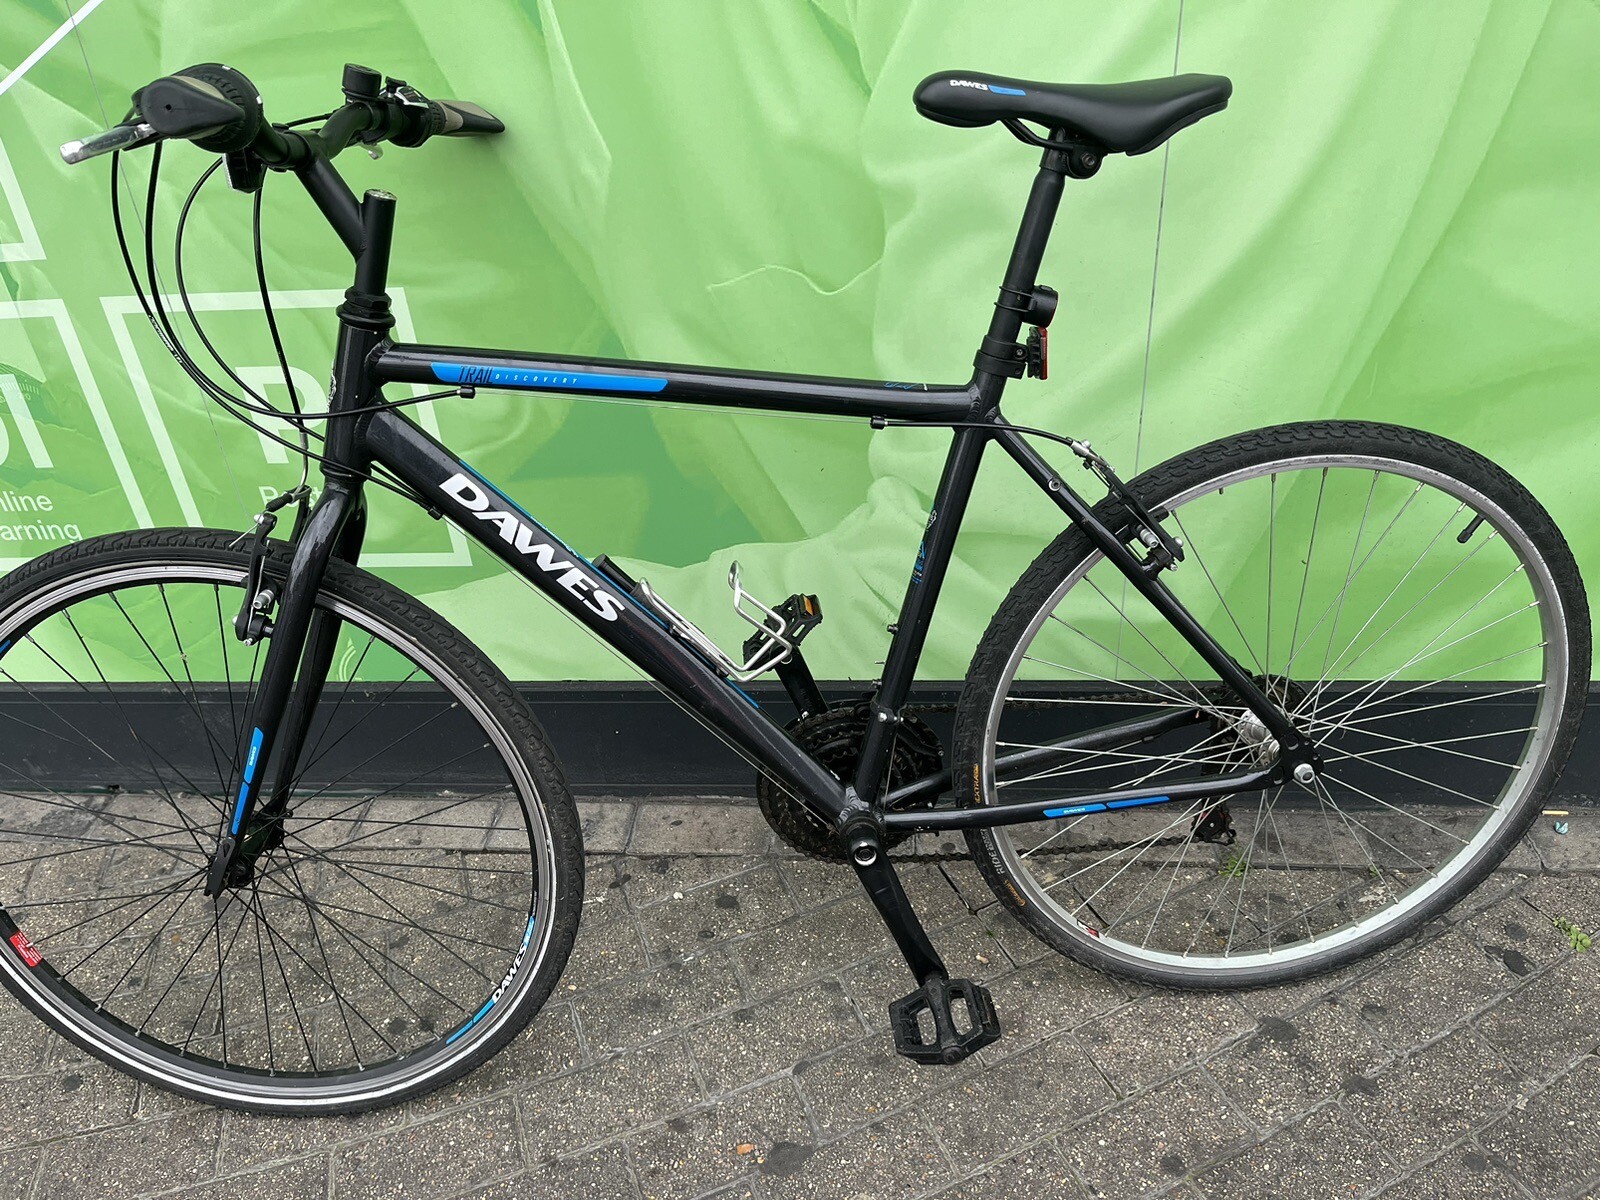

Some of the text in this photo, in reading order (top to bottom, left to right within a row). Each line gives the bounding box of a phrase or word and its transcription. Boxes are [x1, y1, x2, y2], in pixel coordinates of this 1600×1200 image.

[949, 79, 988, 90] DAWES
[458, 365, 577, 384] TRAIL DISCOVERY
[438, 472, 625, 621] DAWES
[492, 942, 526, 1004] DAWES
